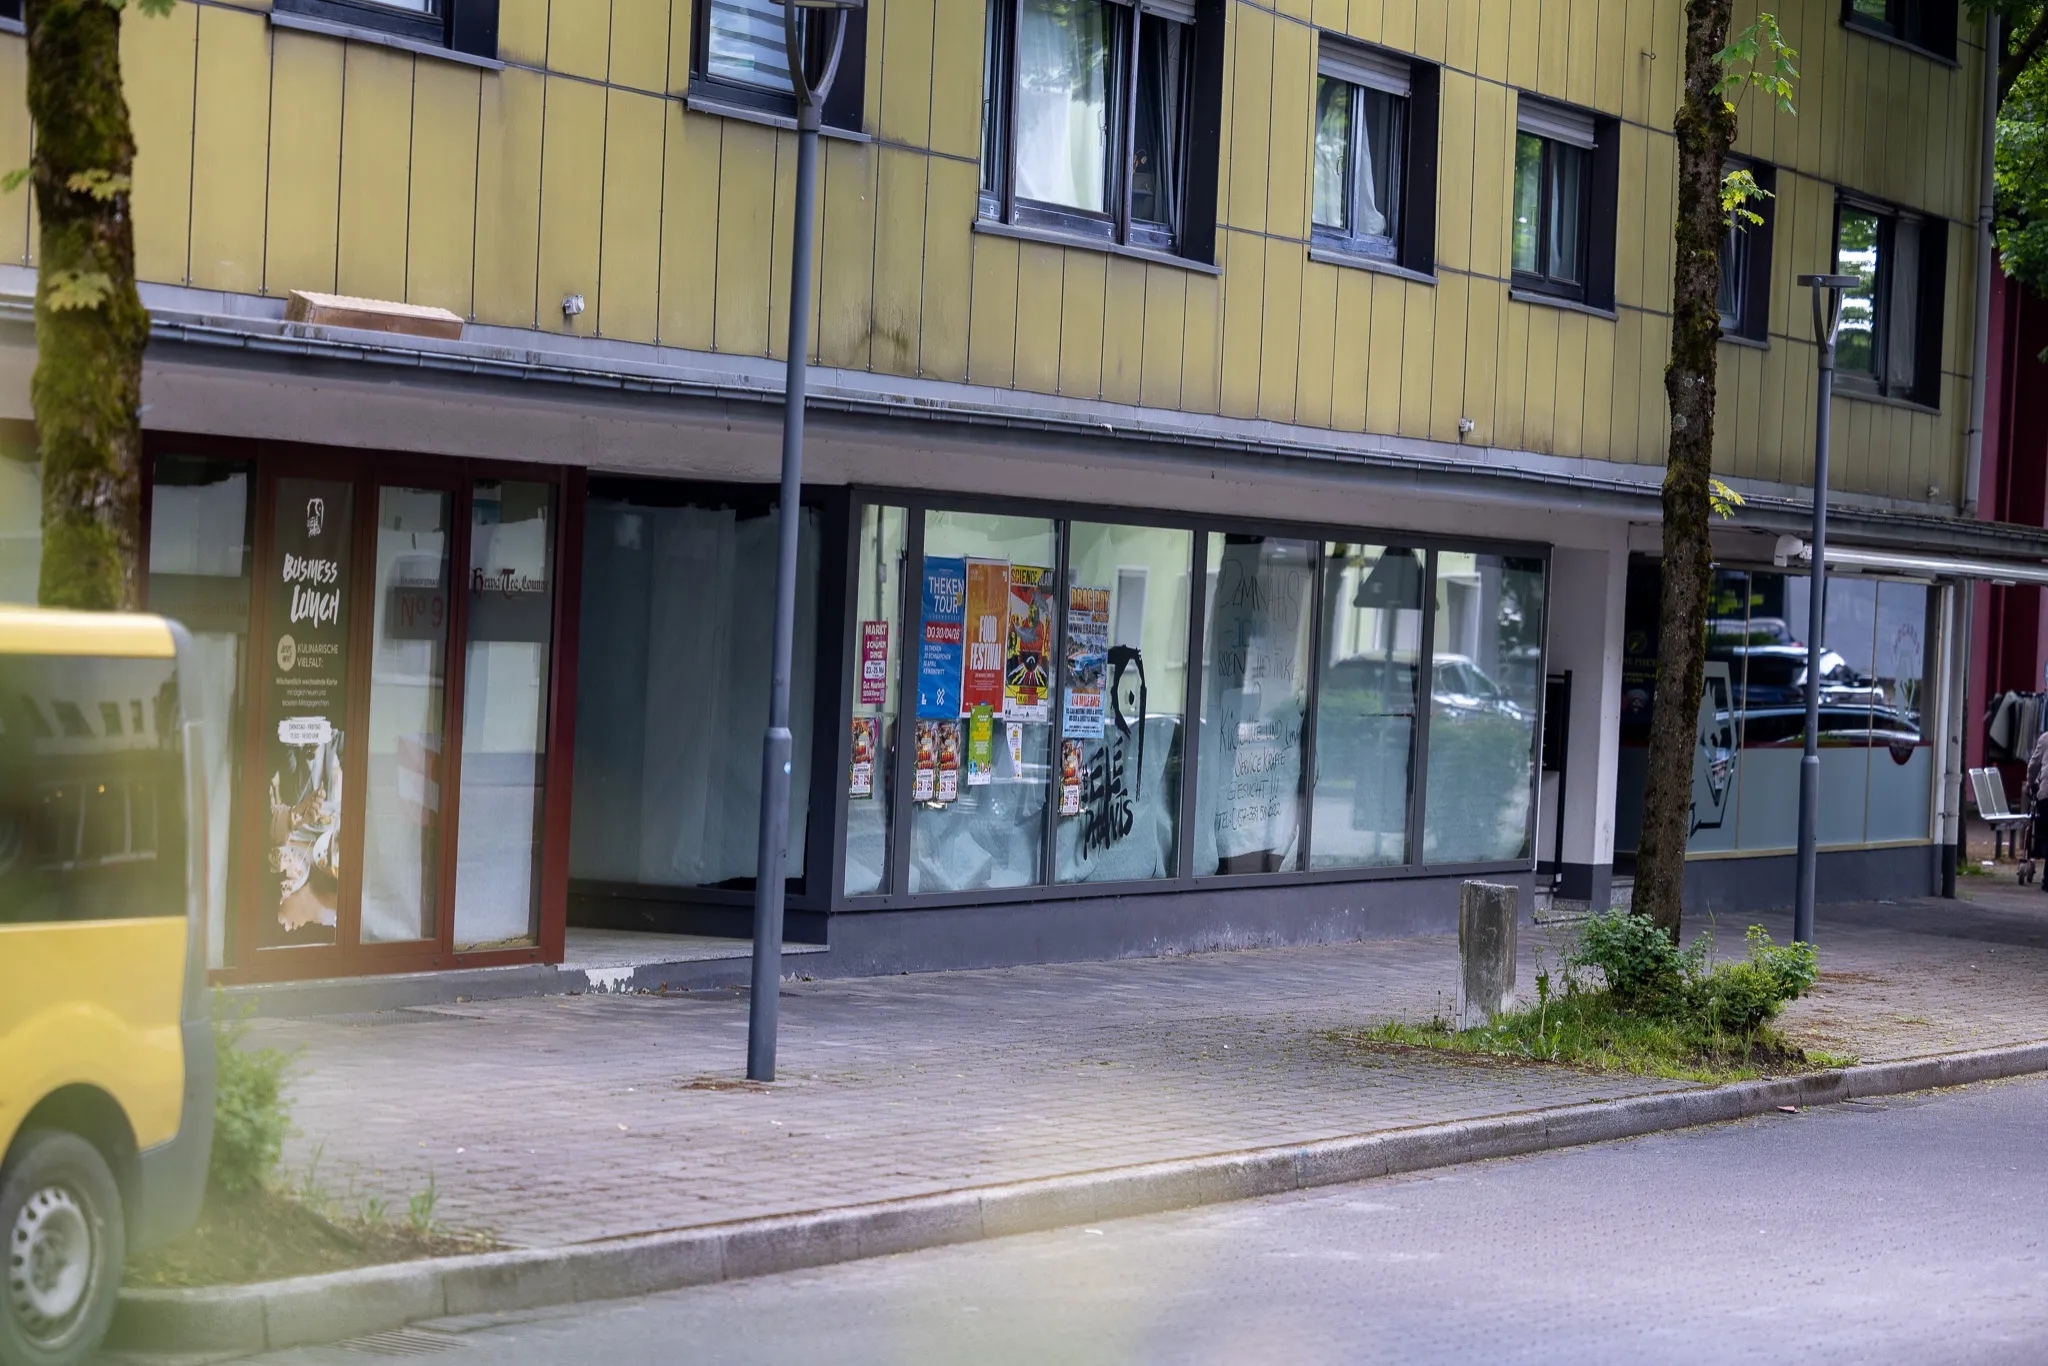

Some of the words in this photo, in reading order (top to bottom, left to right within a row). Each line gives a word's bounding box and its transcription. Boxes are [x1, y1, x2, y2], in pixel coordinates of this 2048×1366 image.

[283, 553, 337, 586] BUSINESS
[1010, 568, 1038, 586] SCIENCE
[928, 576, 964, 597] THEKEN
[290, 584, 340, 628] LUNCH
[934, 595, 958, 614] TOUR
[1070, 586, 1093, 612] DRAG
[1093, 588, 1110, 613] DAY
[430, 596, 444, 629] 9
[865, 624, 887, 636] MARKT
[979, 615, 997, 643] FOOD
[297, 643, 339, 654] KULINARISCHE
[969, 643, 1001, 670] FESTIVAL
[296, 657, 324, 668] VIELFALT:
